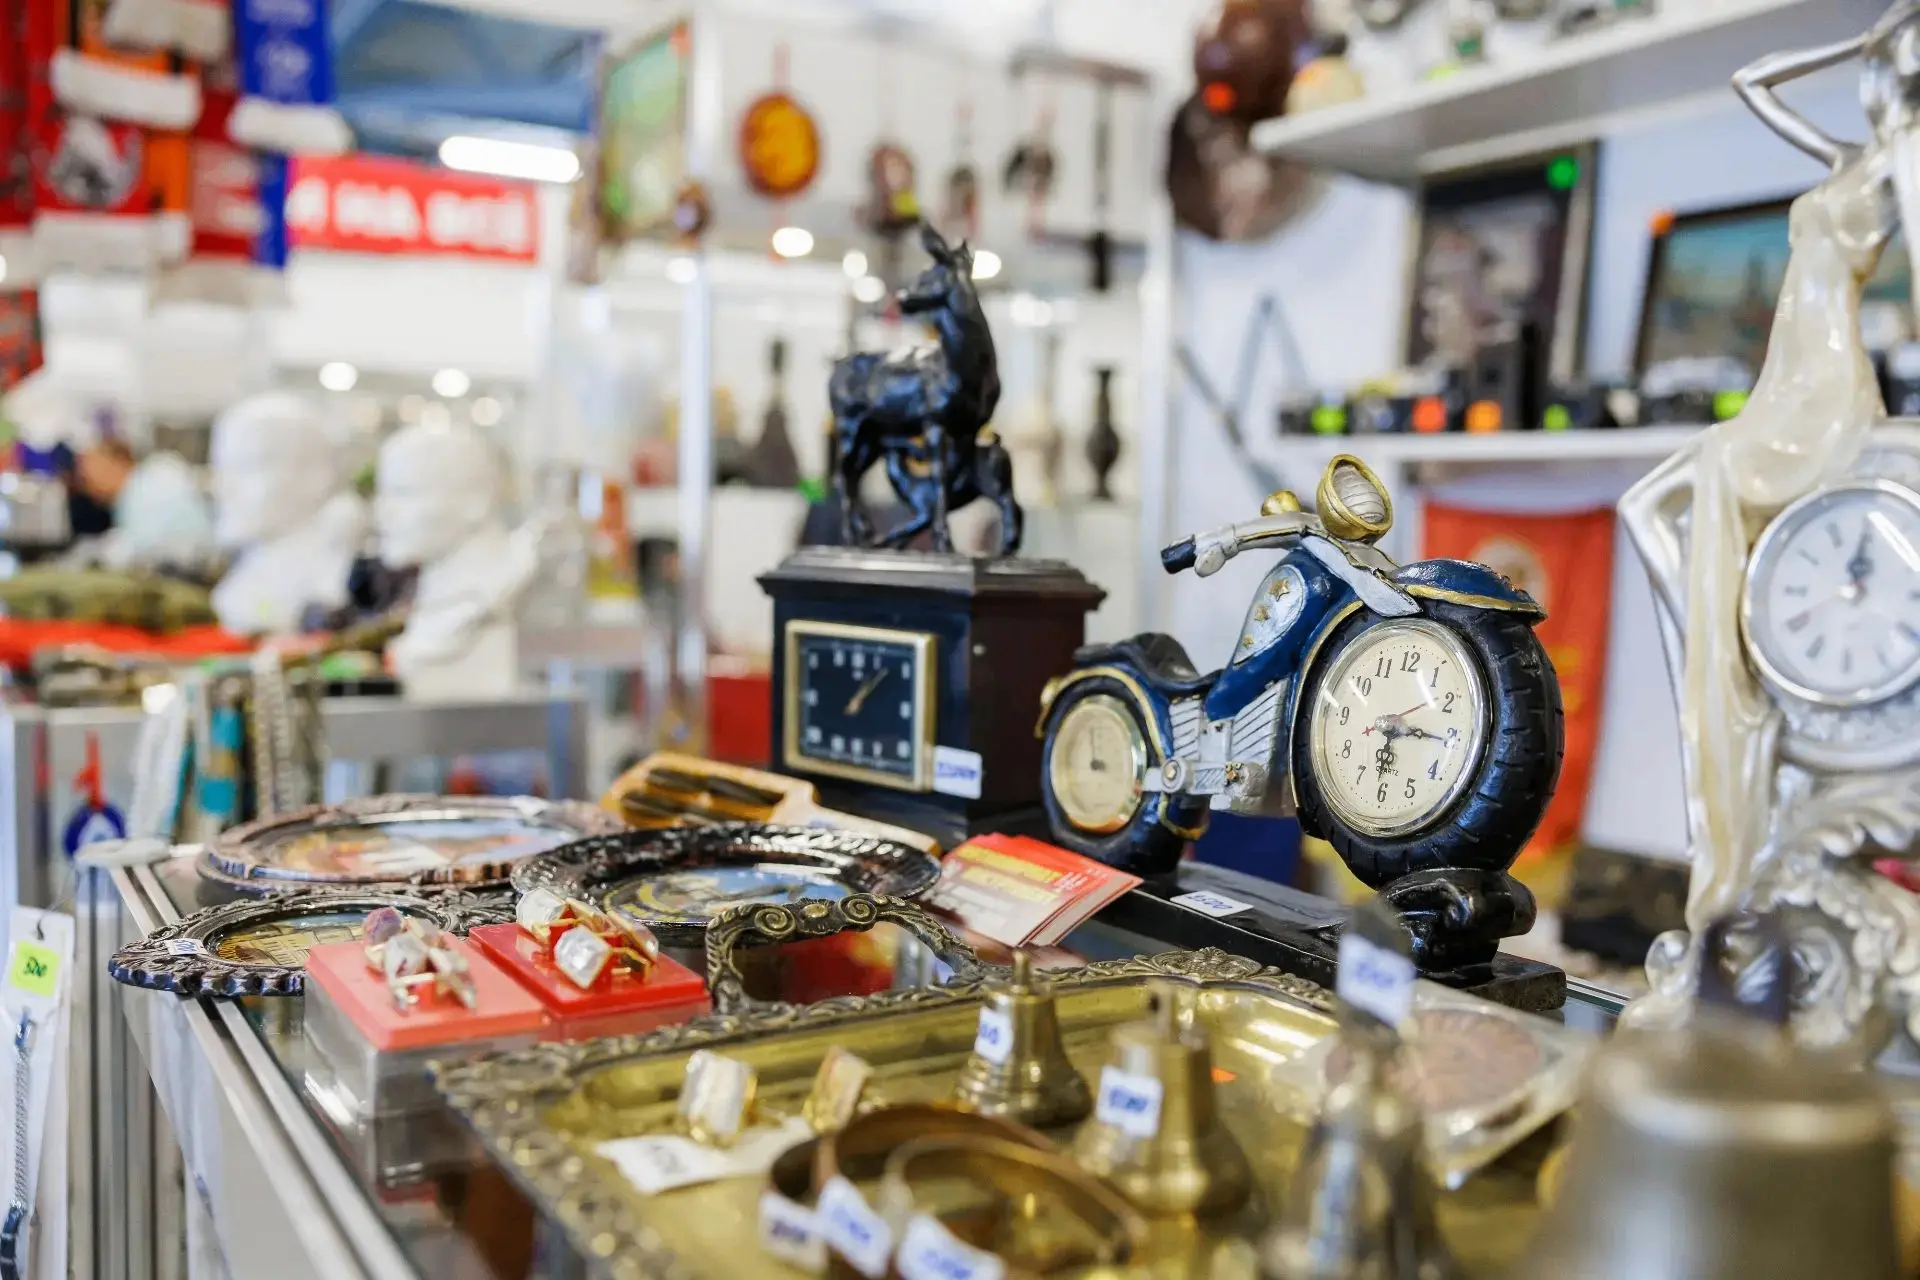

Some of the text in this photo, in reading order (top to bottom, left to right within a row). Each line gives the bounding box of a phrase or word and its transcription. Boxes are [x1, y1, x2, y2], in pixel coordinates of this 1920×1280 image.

[1375, 657, 1393, 679] 11
[1400, 651, 1421, 673] 12
[1355, 675, 1372, 697] 10
[1430, 666, 1440, 688] 1
[1441, 691, 1455, 714] 2
[1339, 706, 1350, 726] 9
[1341, 739, 1352, 759] 8
[1443, 727, 1458, 749] 3
[1357, 764, 1367, 785] 7
[1427, 759, 1439, 780] 4
[1376, 782, 1389, 803] 6
[1404, 777, 1416, 799] 5
